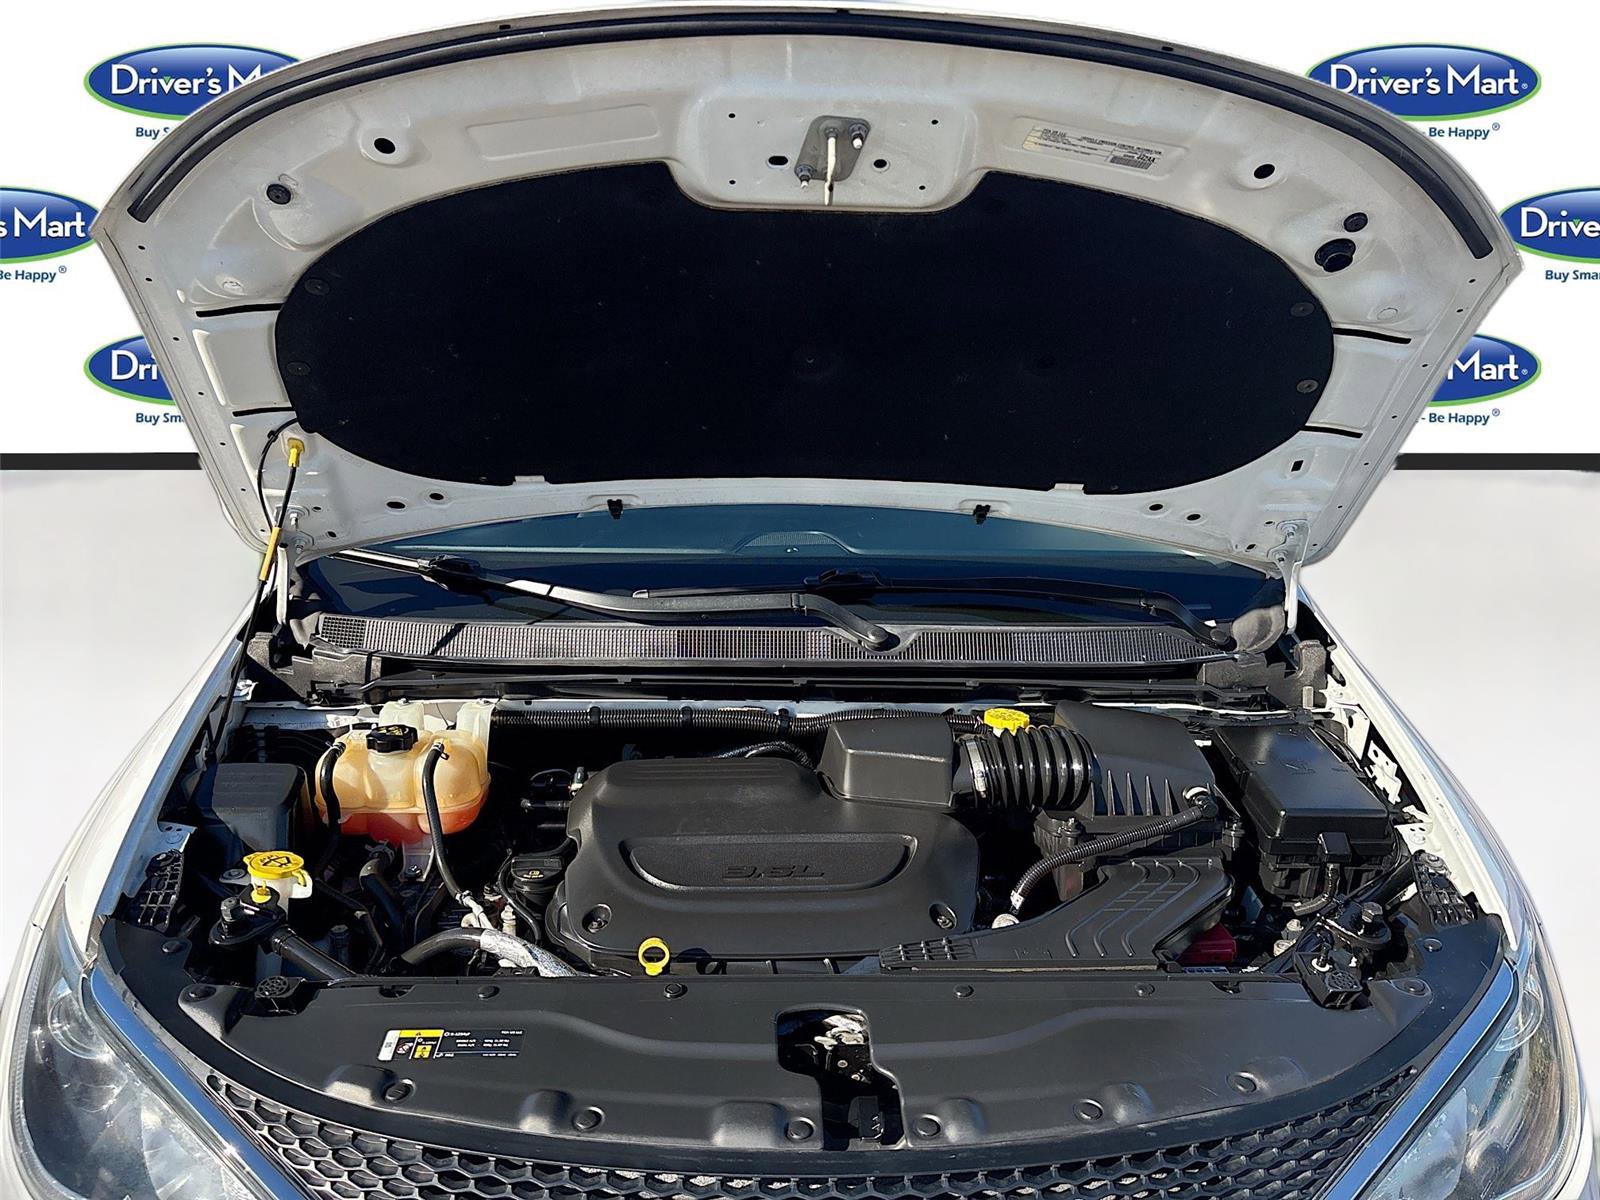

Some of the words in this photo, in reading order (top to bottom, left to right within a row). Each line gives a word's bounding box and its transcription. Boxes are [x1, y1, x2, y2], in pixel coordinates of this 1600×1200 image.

[111, 64, 222, 95] Driver's
[1330, 64, 1441, 95] Driver's
[1447, 64, 1519, 95] Mart
[136, 127, 160, 140] Buy
[1429, 127, 1445, 137] Be
[1448, 127, 1490, 140] Happy
[14, 206, 86, 238] Mart
[15, 270, 57, 283] Happy
[1545, 270, 1569, 283] Buy
[1447, 349, 1519, 380] Mart
[136, 413, 160, 425] Buy
[1429, 413, 1445, 423] Be
[1448, 413, 1490, 425] Happy
